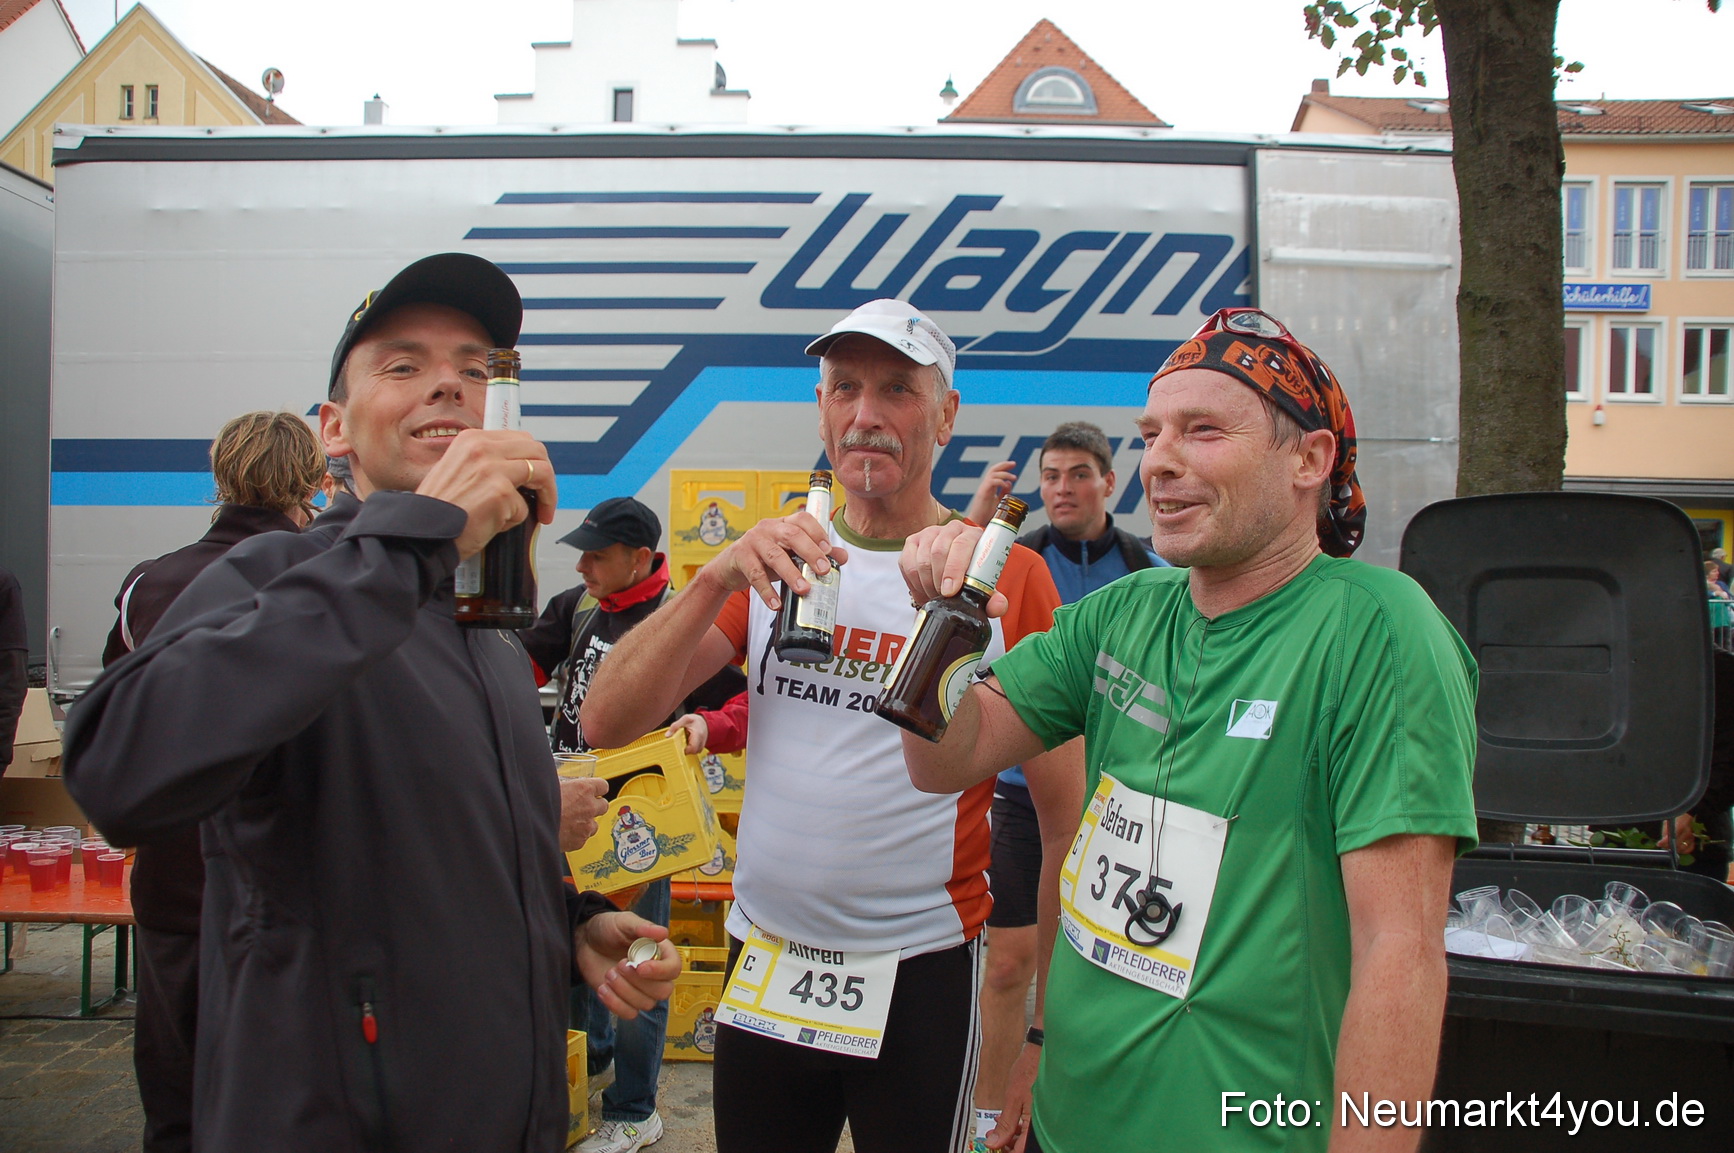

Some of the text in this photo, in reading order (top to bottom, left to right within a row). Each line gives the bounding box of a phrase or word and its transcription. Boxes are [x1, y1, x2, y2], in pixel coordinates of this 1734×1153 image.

[832, 624, 908, 667] IER
[774, 676, 876, 713] TEAM 20
[1245, 703, 1273, 720] AOK
[1100, 796, 1144, 844] Sefan
[743, 954, 757, 971] C
[1111, 945, 1187, 985] PFLEIDERER
[788, 970, 866, 1011] 435
[817, 1030, 878, 1050] PFLEIDERER
